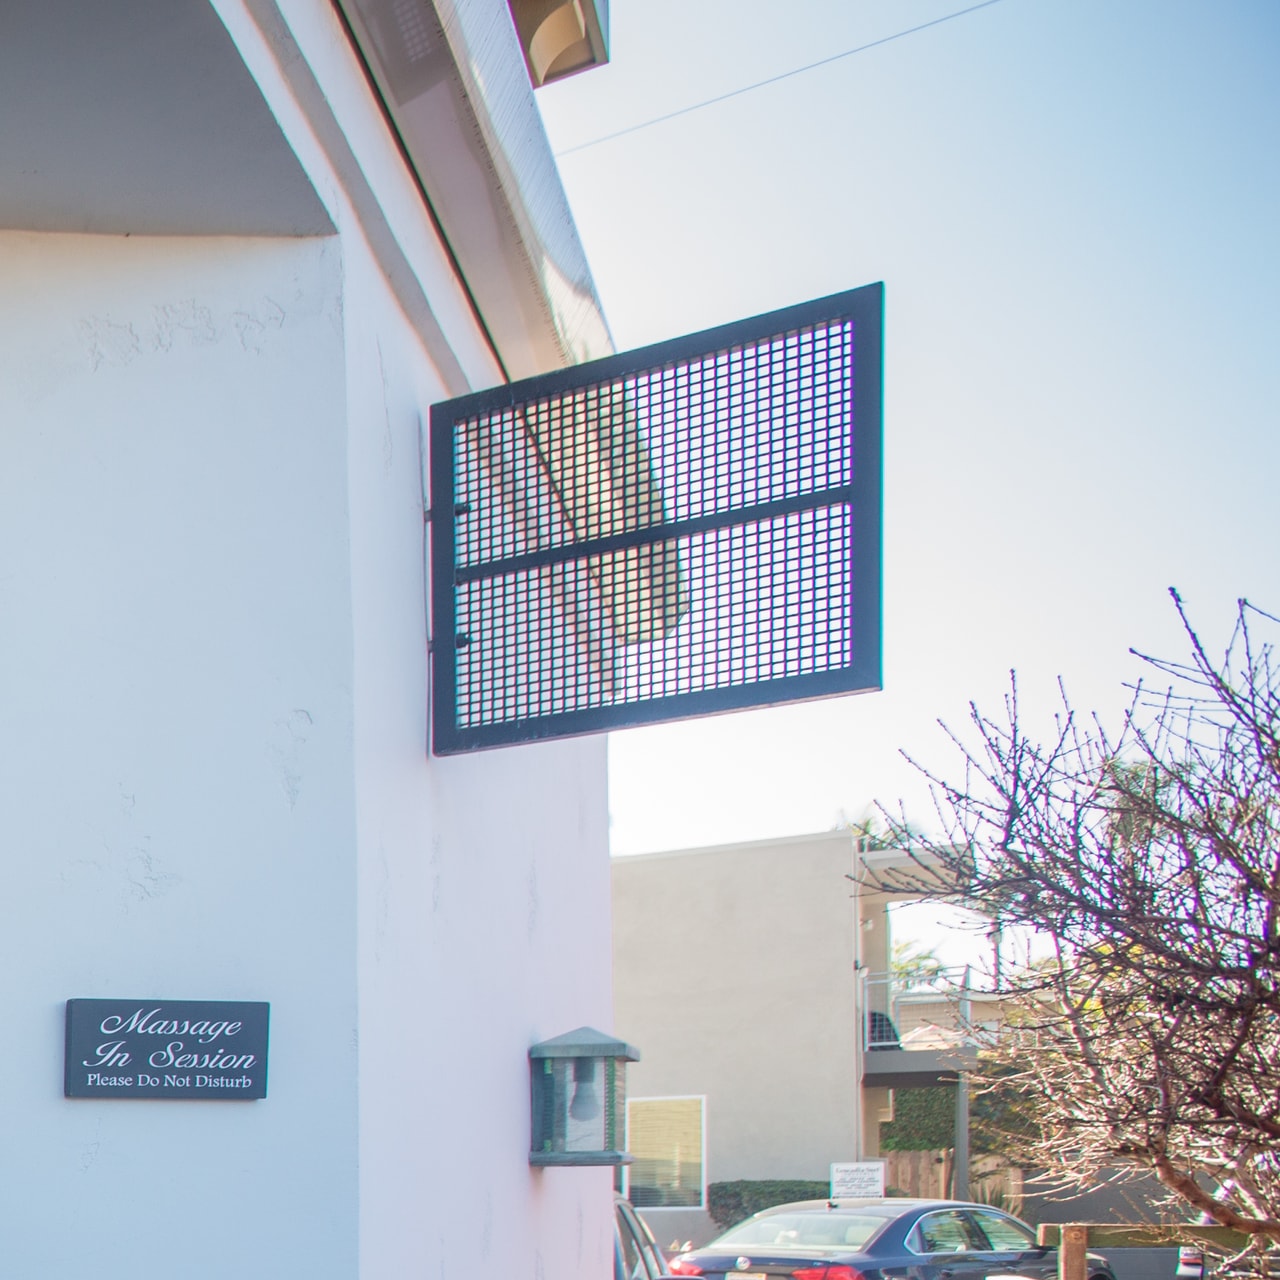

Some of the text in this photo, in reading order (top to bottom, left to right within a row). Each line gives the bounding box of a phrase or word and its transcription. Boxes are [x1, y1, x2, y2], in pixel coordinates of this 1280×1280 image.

[100, 1008, 242, 1044] Massage
[82, 1041, 257, 1069] In Session
[87, 1073, 252, 1088] Please Do Not Disturb
